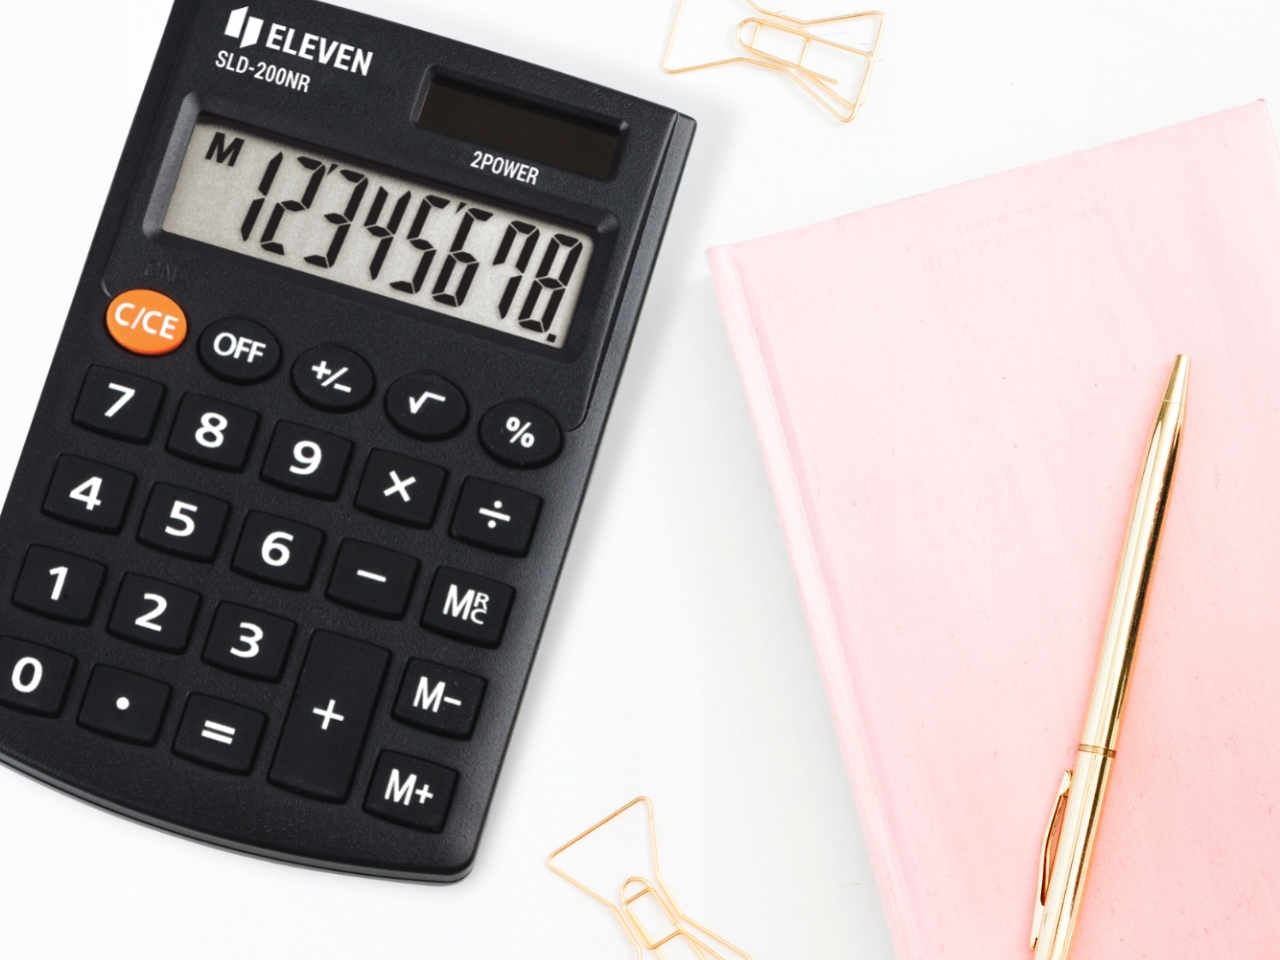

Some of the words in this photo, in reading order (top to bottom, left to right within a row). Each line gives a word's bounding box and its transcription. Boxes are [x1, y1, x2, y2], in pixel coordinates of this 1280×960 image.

[265, 23, 373, 77] ELEVEN
[215, 50, 311, 93] SLD-200NR
[205, 131, 244, 167] M
[470, 151, 539, 185] 2POWER
[115, 303, 178, 339] C/CE
[214, 332, 266, 362] OFF
[105, 383, 135, 417] 7
[195, 413, 227, 448] 8
[506, 417, 534, 448] %
[290, 441, 322, 475] 9
[70, 477, 102, 510] 4
[165, 501, 197, 536] 5
[262, 531, 293, 566] 6
[50, 566, 68, 600] 1
[135, 593, 167, 631] 2
[230, 622, 263, 658] 3
[12, 657, 42, 692] 0
[202, 720, 235, 744] =
[313, 700, 344, 730] +
[385, 769, 433, 805] M+
